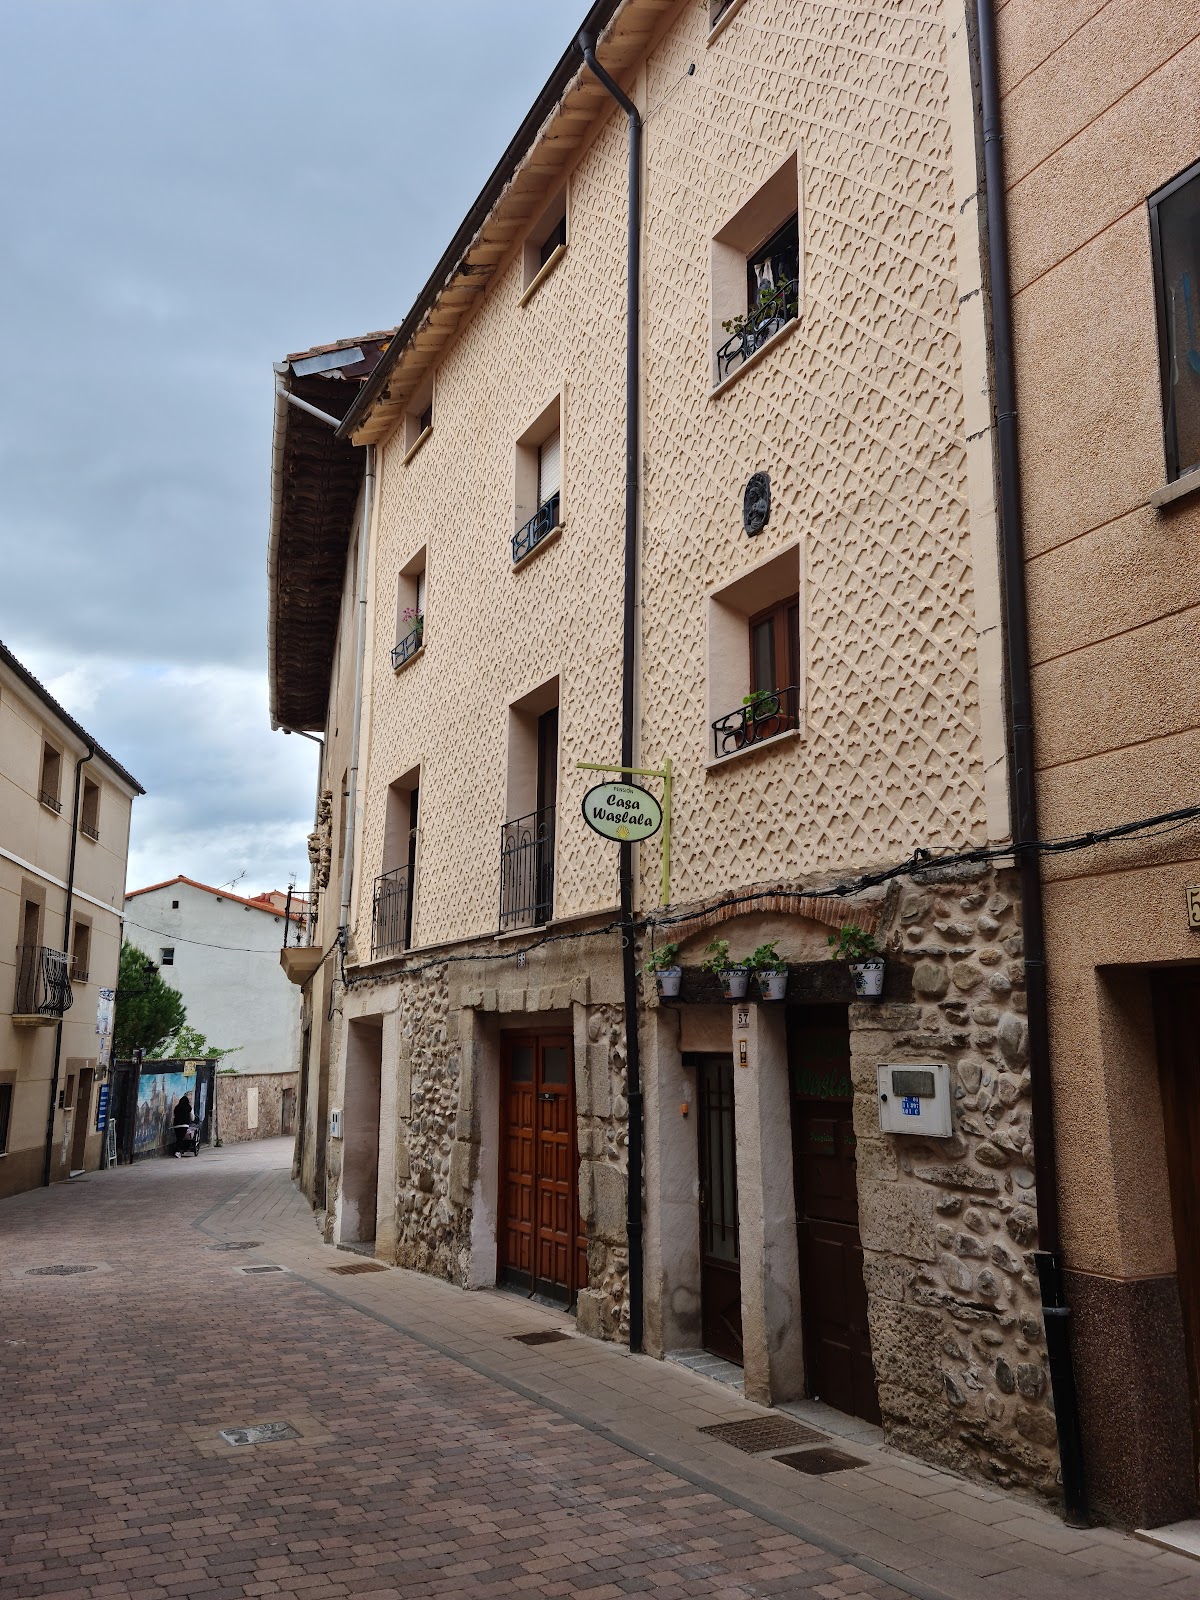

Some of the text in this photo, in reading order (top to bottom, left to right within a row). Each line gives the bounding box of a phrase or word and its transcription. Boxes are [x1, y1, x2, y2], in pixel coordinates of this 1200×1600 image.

[606, 794, 640, 810] Casa
[593, 807, 653, 827] Waslala
[738, 1013, 749, 1024] 57
